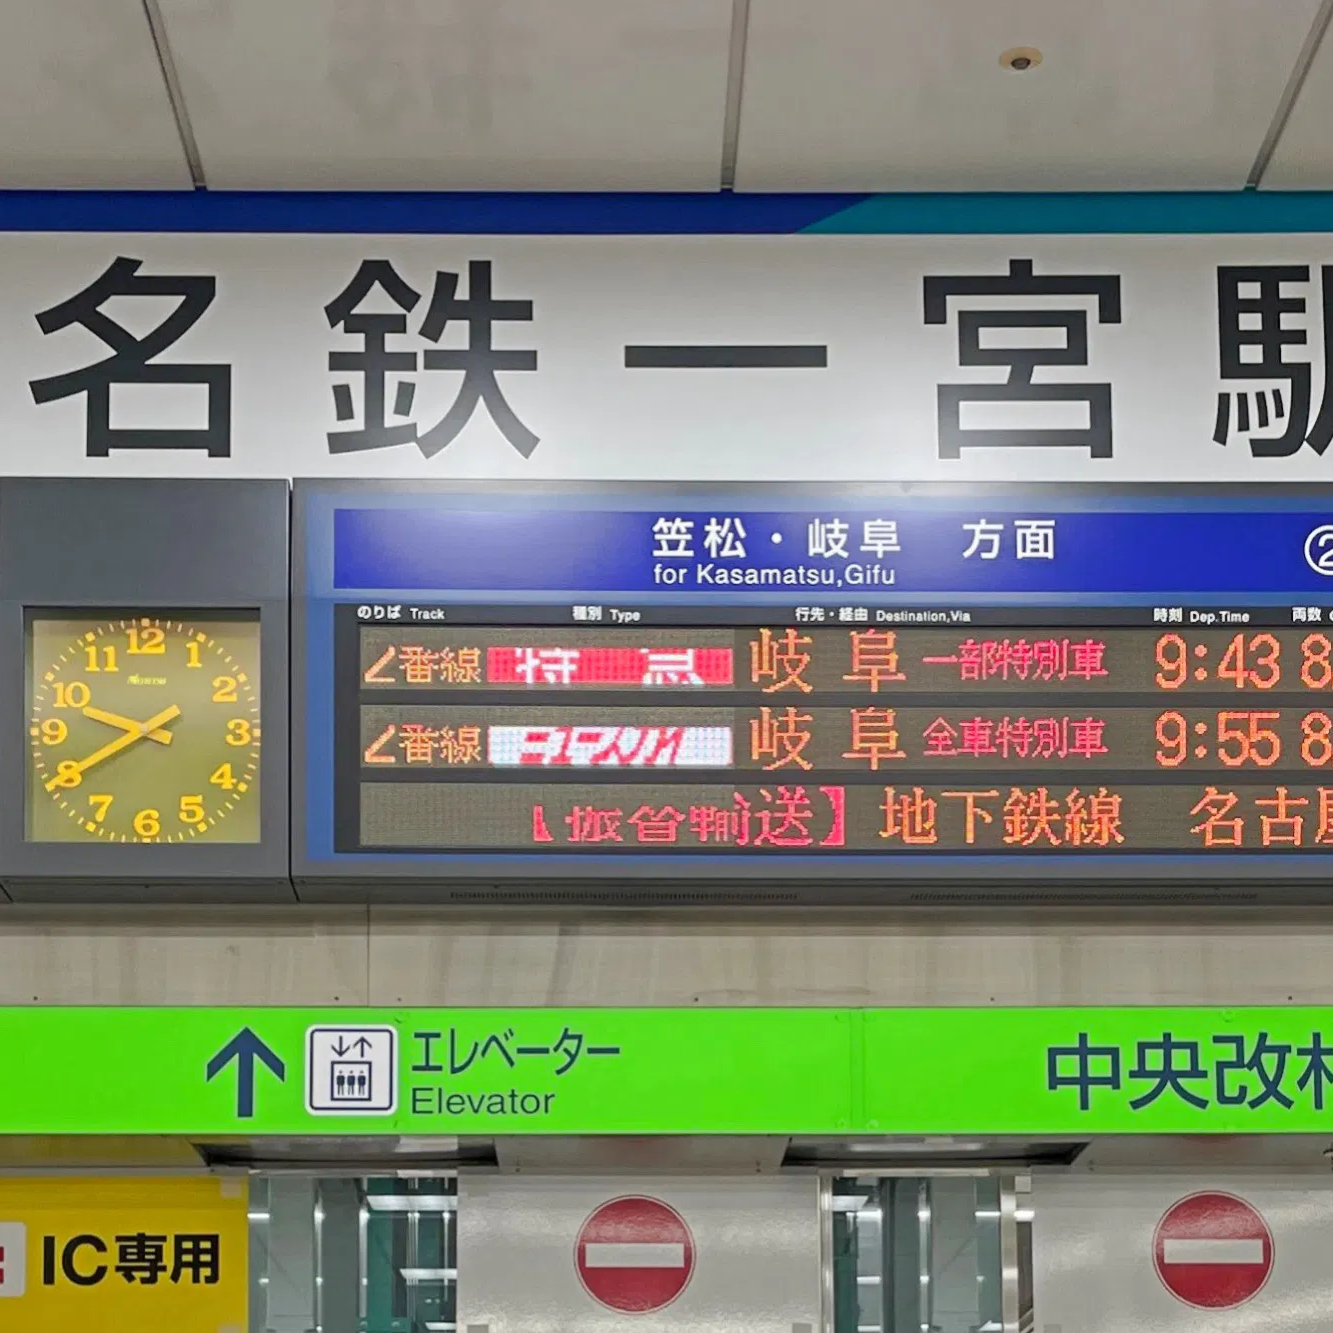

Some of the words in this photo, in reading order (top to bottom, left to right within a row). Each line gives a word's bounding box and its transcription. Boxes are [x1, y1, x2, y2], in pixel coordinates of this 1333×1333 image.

[652, 517, 902, 560] 笠松・岐阜
[962, 518, 1057, 560] 方面
[653, 565, 689, 585] for
[696, 563, 897, 588] Kasamatsu,Gifu
[357, 605, 402, 620] のりば
[410, 607, 445, 621] Track
[572, 605, 603, 622] 種別
[609, 608, 641, 624] Type
[1153, 607, 1183, 624] 時刻
[1189, 609, 1251, 626] Dep.Time
[1292, 607, 1322, 624] 両数
[125, 626, 166, 656] 12
[185, 641, 202, 669] 1
[86, 644, 118, 672] 11
[749, 628, 907, 694] 岐阜
[921, 638, 1110, 682] 一部特別車
[1154, 633, 1281, 690] 9:43
[52, 680, 91, 708] 10
[213, 676, 238, 703] 2
[41, 717, 69, 746] 9
[227, 718, 252, 746] 3
[749, 706, 907, 772] 岐阜
[921, 716, 1110, 760] 全車特別車
[1154, 711, 1281, 768] 9:55
[56, 759, 83, 788] 8
[210, 762, 234, 790] 4
[89, 793, 114, 822] 7
[179, 795, 205, 823] 5
[878, 786, 1126, 848] 地下鉄線
[134, 808, 161, 837] 6
[412, 1027, 621, 1077] エレベーター
[412, 1086, 556, 1116] Elevator
[42, 1233, 221, 1287] IC専用
